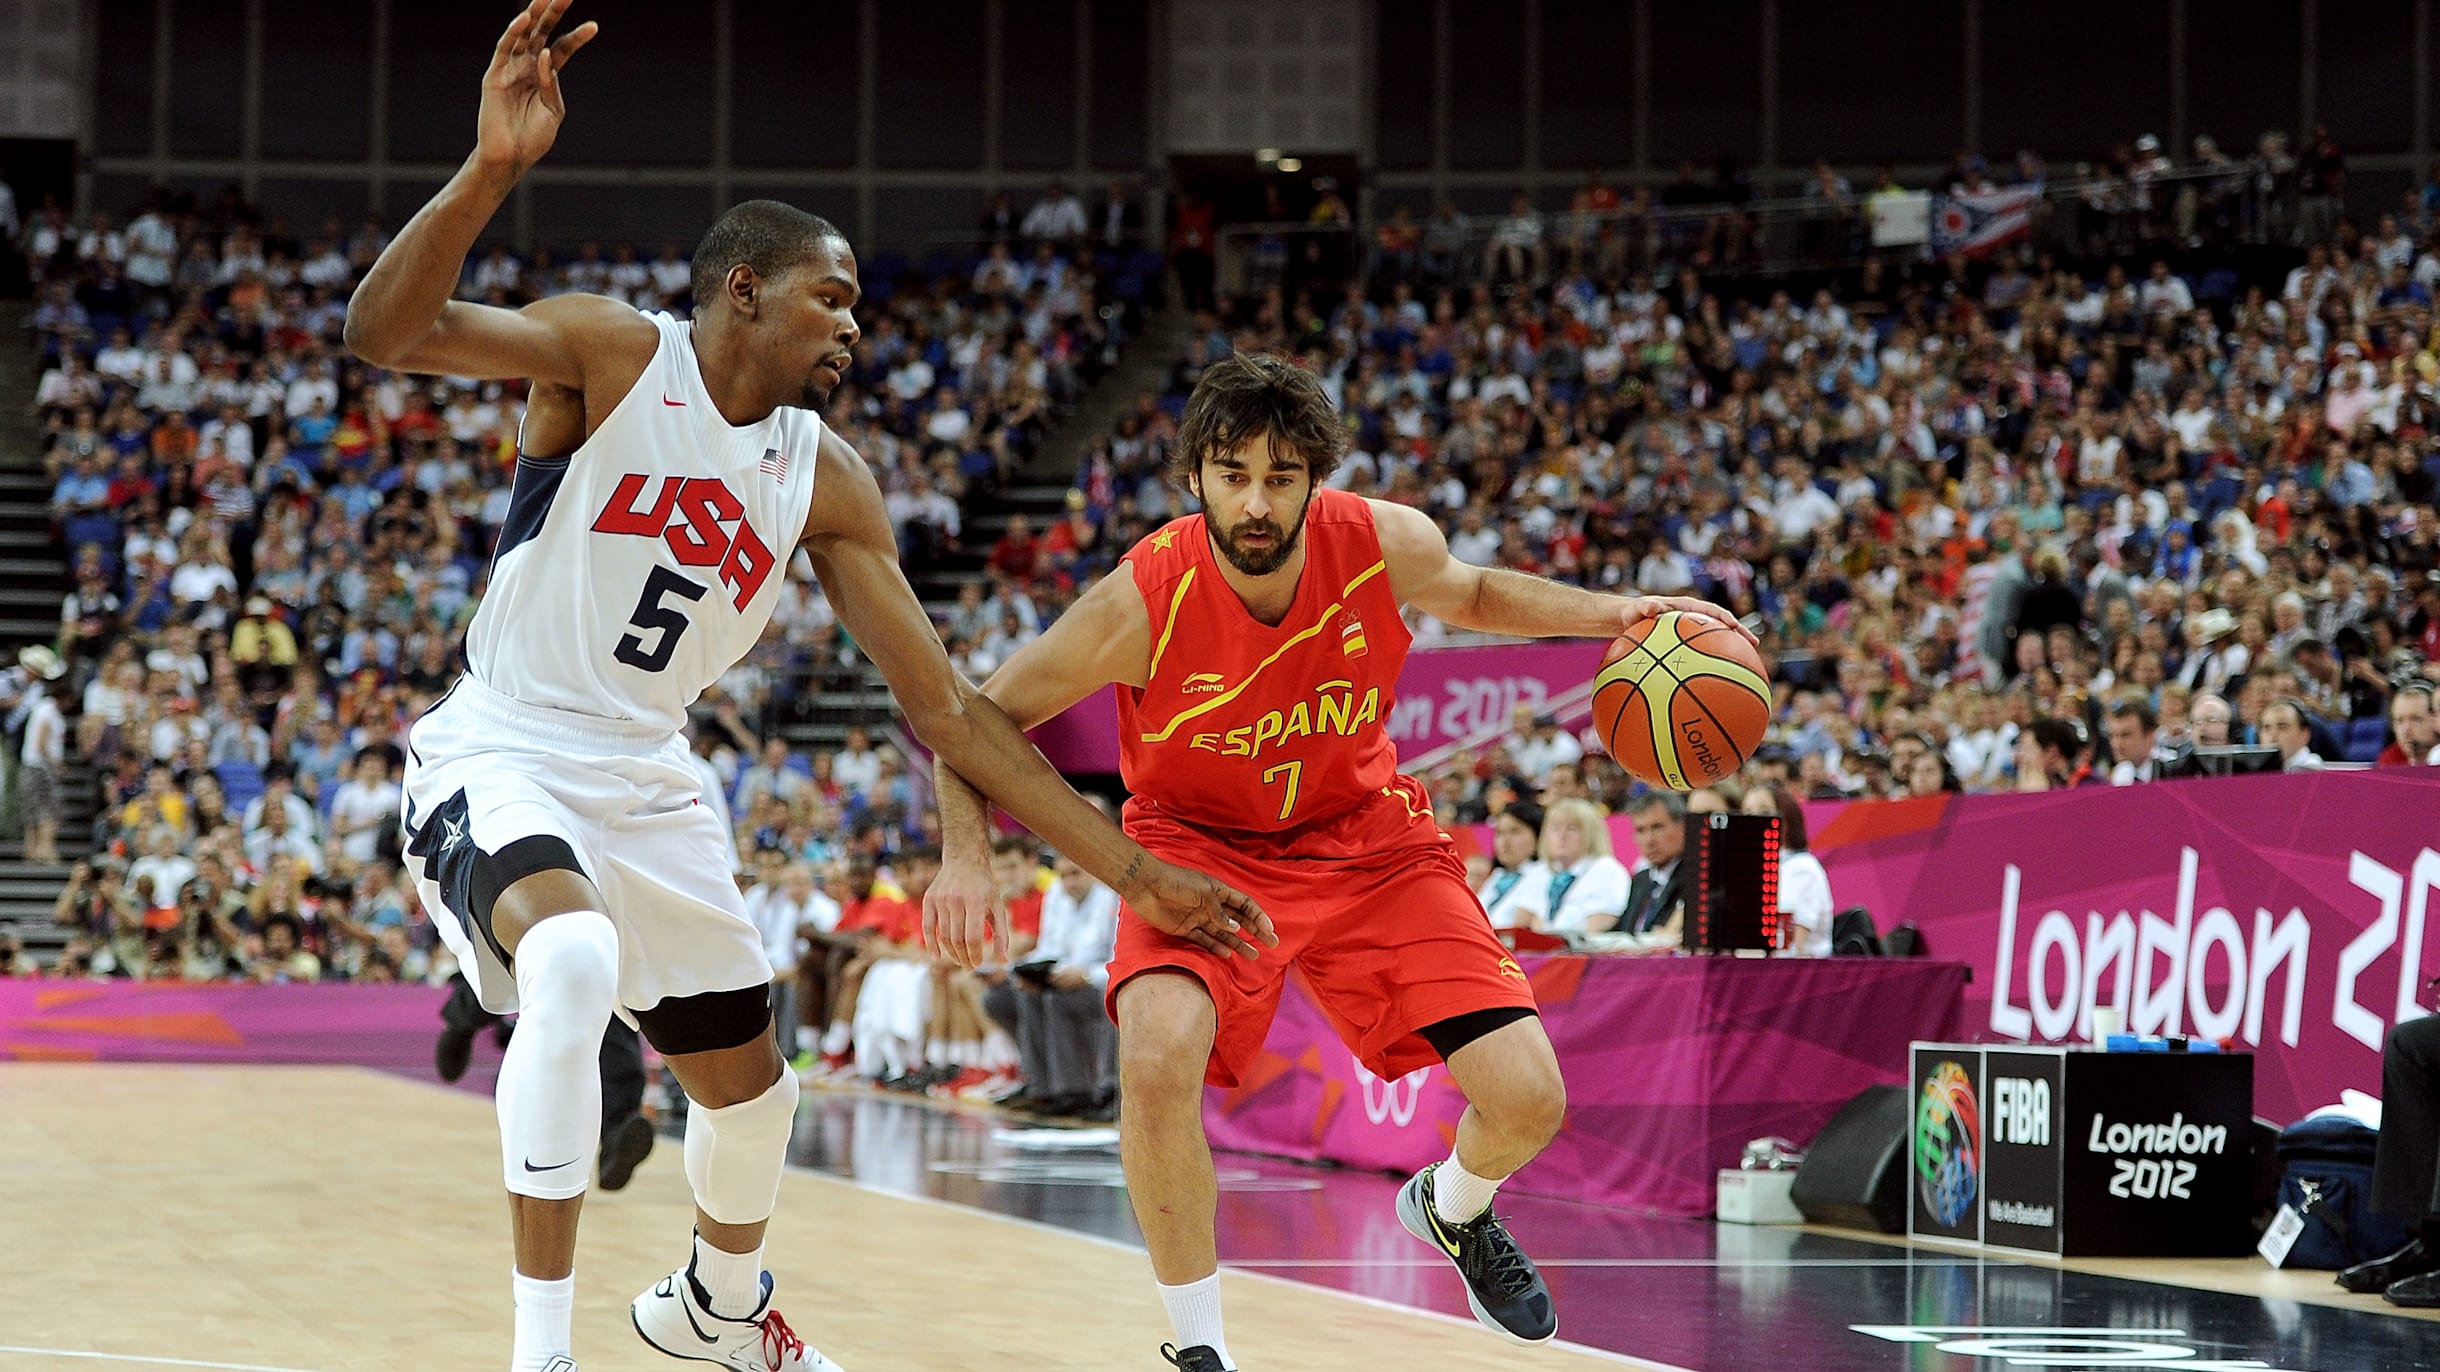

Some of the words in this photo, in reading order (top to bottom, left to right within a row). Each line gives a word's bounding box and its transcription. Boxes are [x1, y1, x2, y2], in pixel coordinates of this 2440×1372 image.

[591, 473, 776, 615] USA
[613, 564, 708, 673] 5
[1181, 684, 1225, 694] LI-NING
[1189, 679, 1381, 761] ESPAÑA
[1681, 718, 1722, 780] London
[1263, 760, 1302, 822] 7
[1990, 846, 2311, 1050] London
[1993, 1077, 2050, 1146] FIBA
[2089, 1112, 2227, 1154] London
[2109, 1159, 2197, 1199] 2012
